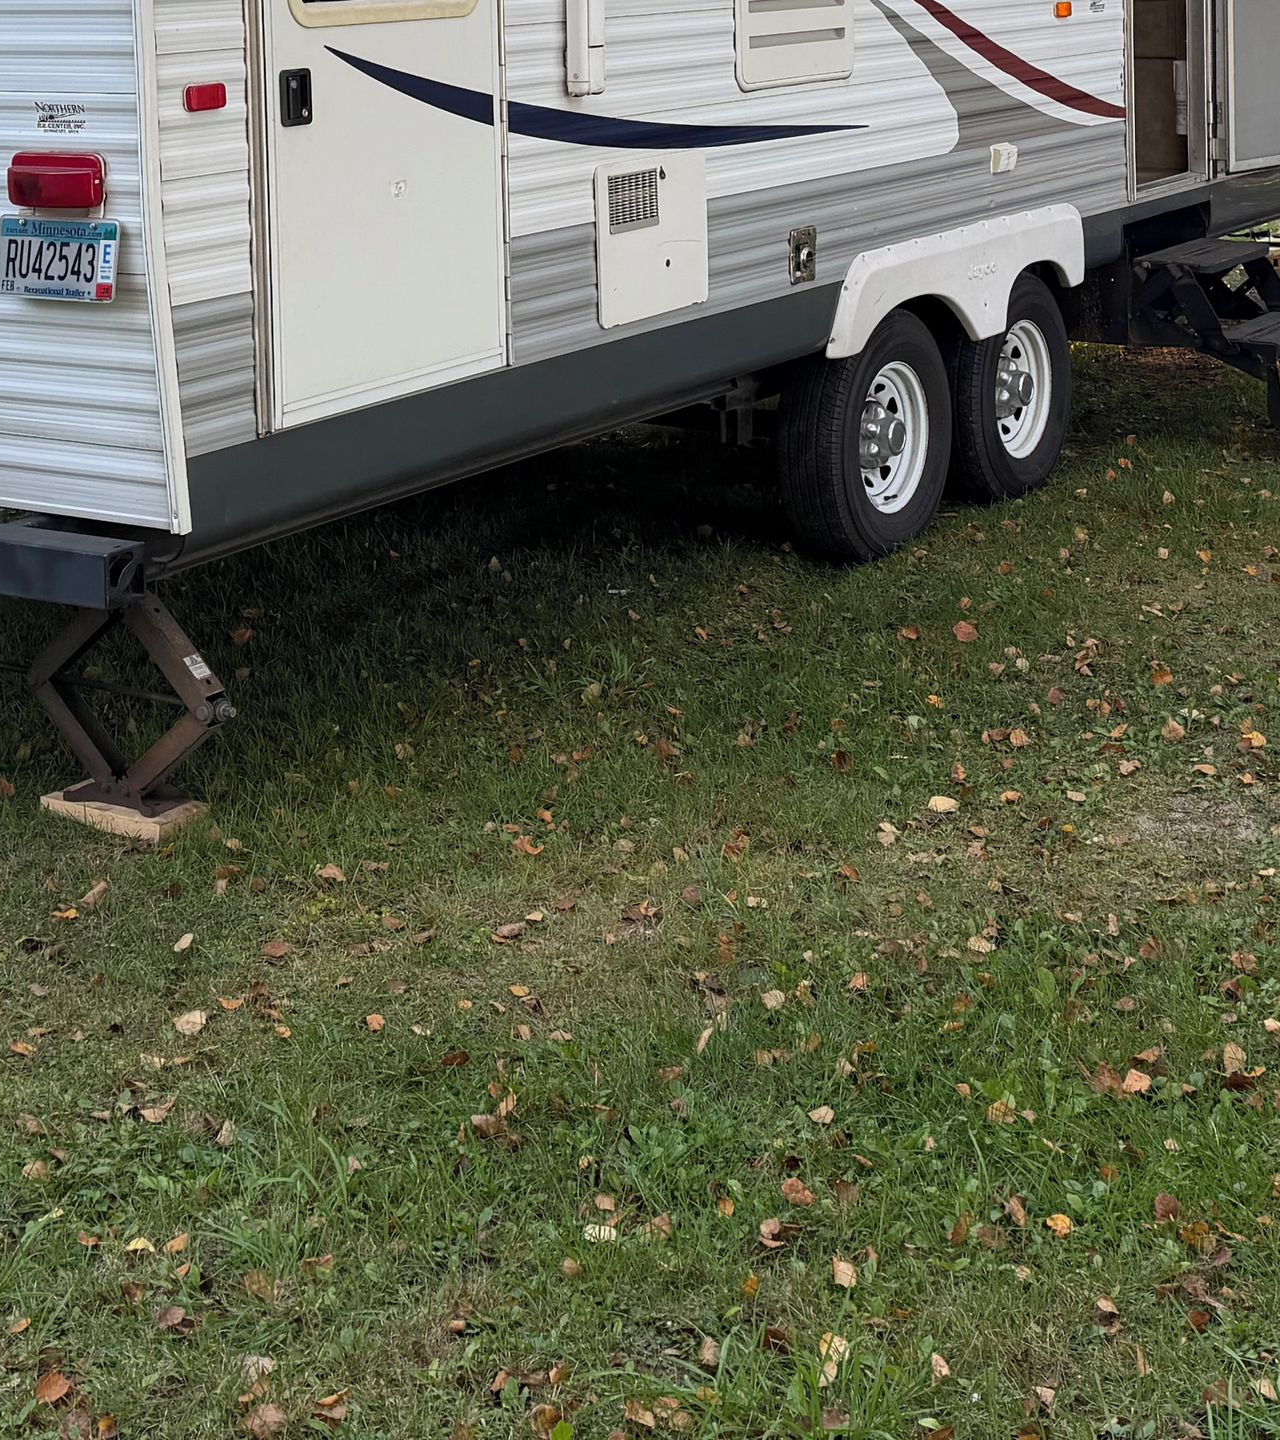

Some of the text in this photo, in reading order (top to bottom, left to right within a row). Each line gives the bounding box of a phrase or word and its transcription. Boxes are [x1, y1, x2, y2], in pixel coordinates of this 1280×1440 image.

[34, 101, 86, 114] NORTHERN
[102, 243, 113, 264] E
[5, 238, 97, 284] RU42543
[1, 279, 15, 292] FEB
[65, 287, 87, 298] Trailer
